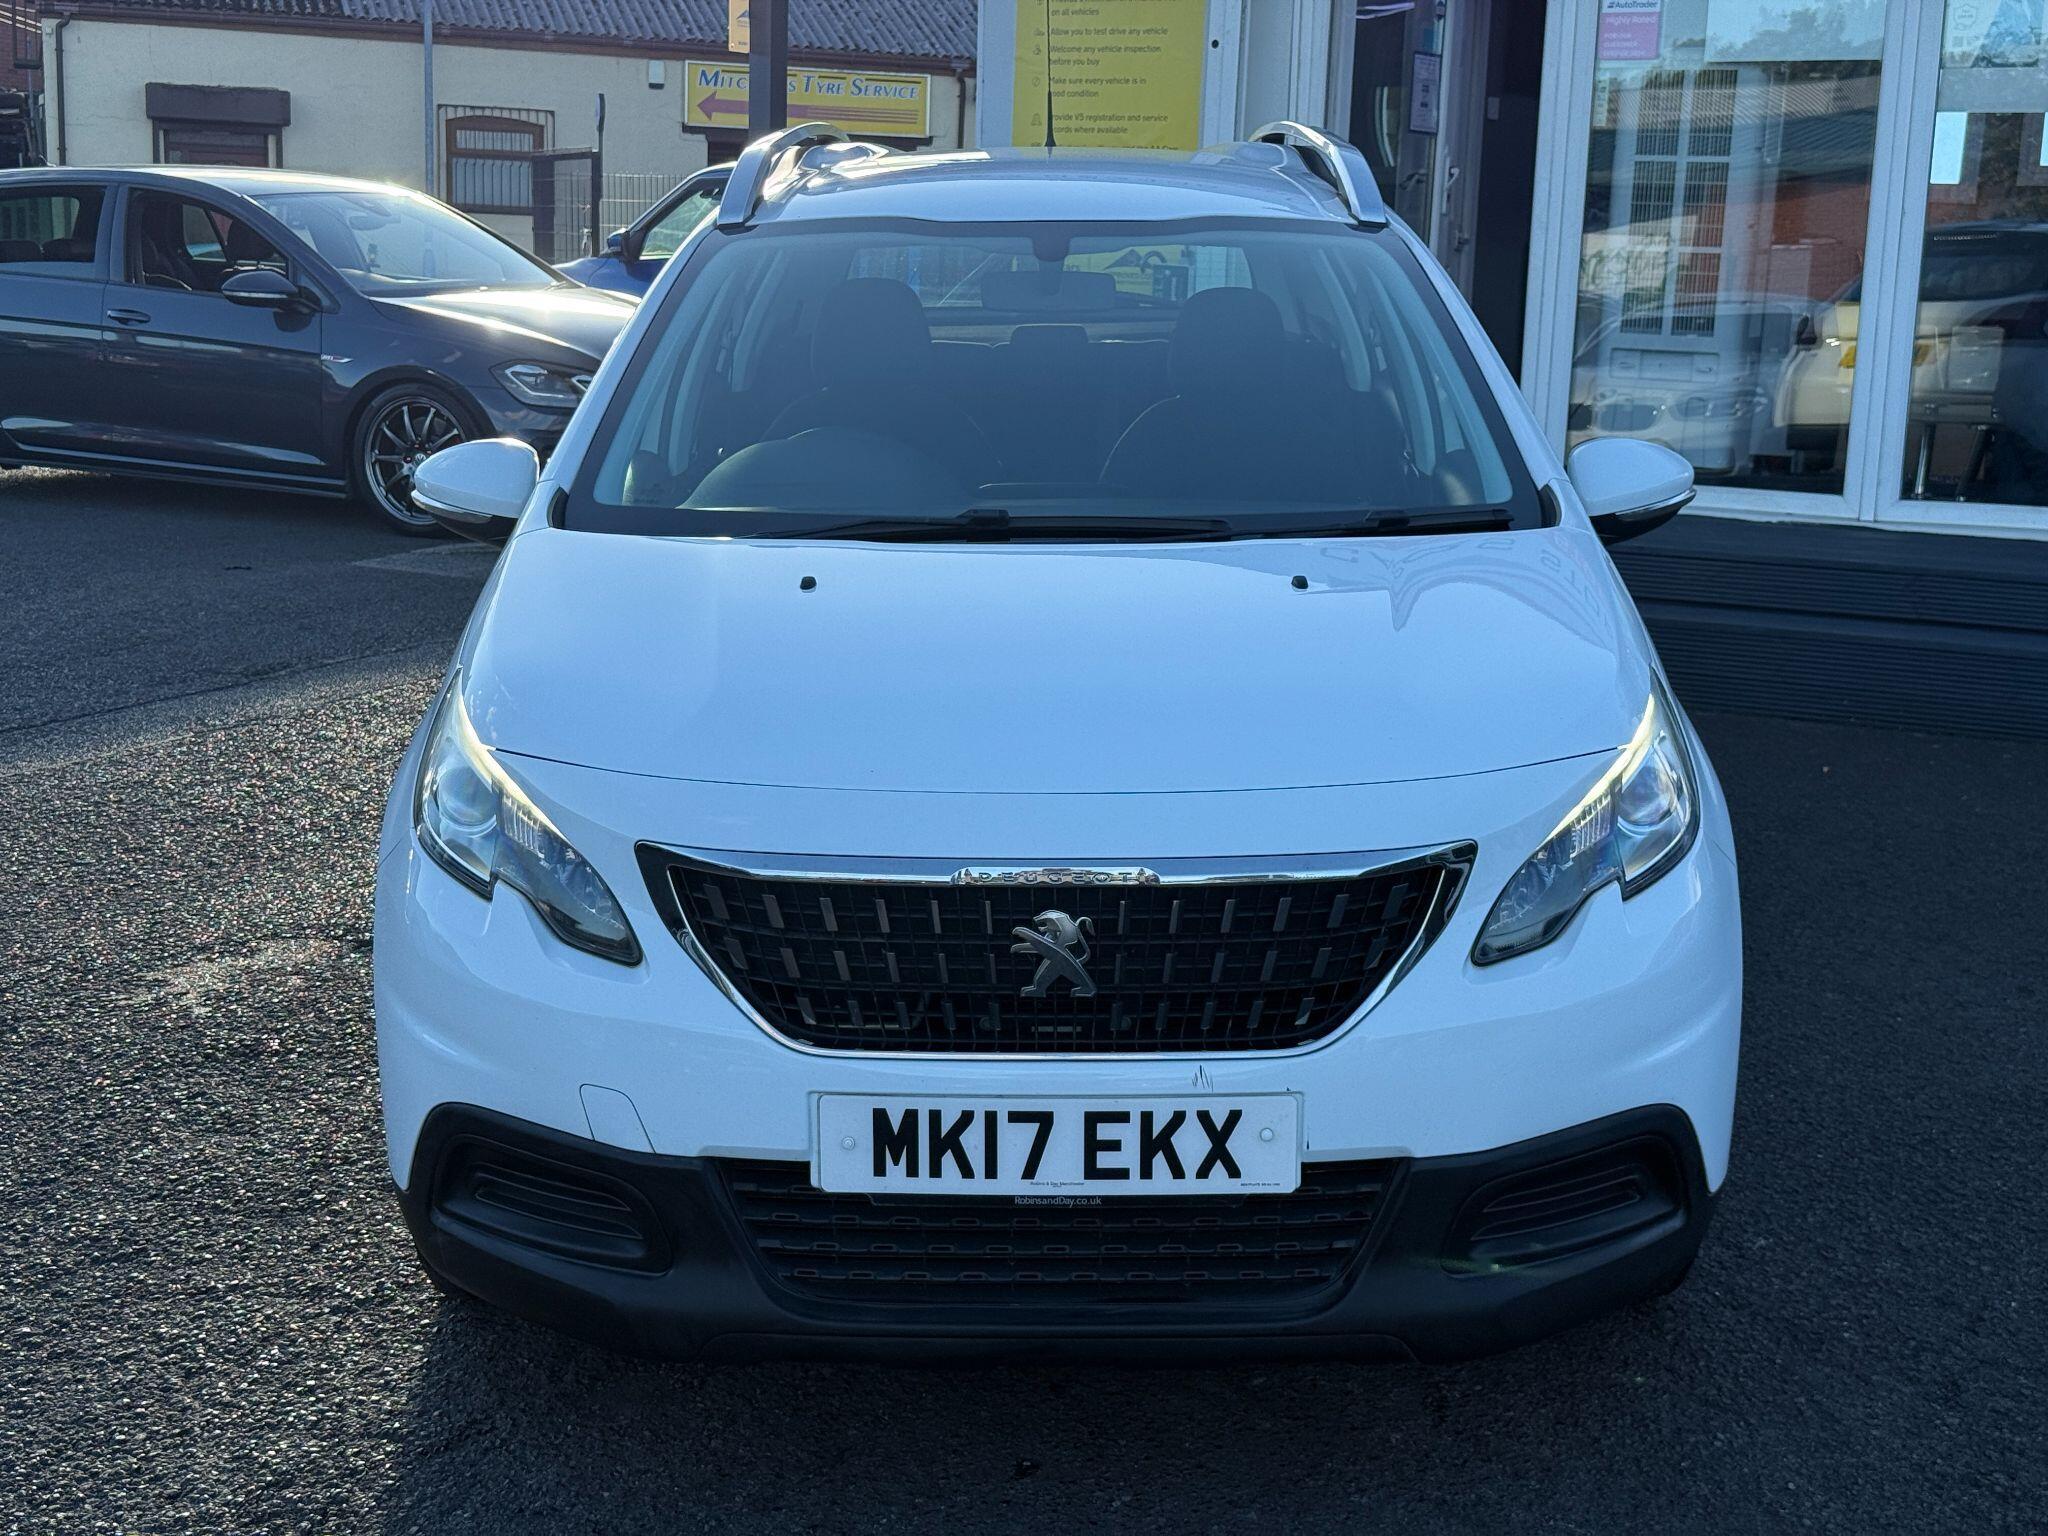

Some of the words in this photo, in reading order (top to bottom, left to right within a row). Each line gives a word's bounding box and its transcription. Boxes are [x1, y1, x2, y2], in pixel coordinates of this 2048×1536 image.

[1615, 0, 1658, 9] AutoTrader
[1061, 8, 1070, 16] all
[1071, 8, 1099, 16] vehicles
[1071, 29, 1083, 37] you
[1094, 27, 1107, 35] test
[1108, 27, 1126, 35] drive
[1128, 29, 1140, 37] any
[1142, 27, 1168, 35] vehicle
[1083, 47, 1096, 55] any
[1097, 45, 1122, 53] vehicle
[1124, 45, 1161, 54] inspection
[1072, 59, 1085, 67] you
[1086, 58, 1099, 67] buy
[699, 69, 796, 92] MITCS
[803, 75, 846, 95] TYRE
[850, 77, 919, 99] SERVICE
[1084, 77, 1105, 86] every
[1105, 76, 1130, 84] vehicle
[1132, 76, 1138, 84] is
[1140, 76, 1147, 84] in
[1051, 90, 1065, 98] ood
[1066, 90, 1099, 98] condition
[1052, 113, 1073, 121] rovide
[1075, 112, 1084, 121] V5
[1085, 113, 1126, 122] registration
[1127, 113, 1141, 121] and
[1142, 114, 1168, 122] service
[1074, 126, 1095, 134] where
[1097, 126, 1128, 134] available
[979, 871, 1133, 884] PEUGEOT
[872, 1107, 1055, 1181] MK17
[1083, 1109, 1243, 1181] EKX
[1014, 1196, 1102, 1208] RobinsandDay.co.uk
